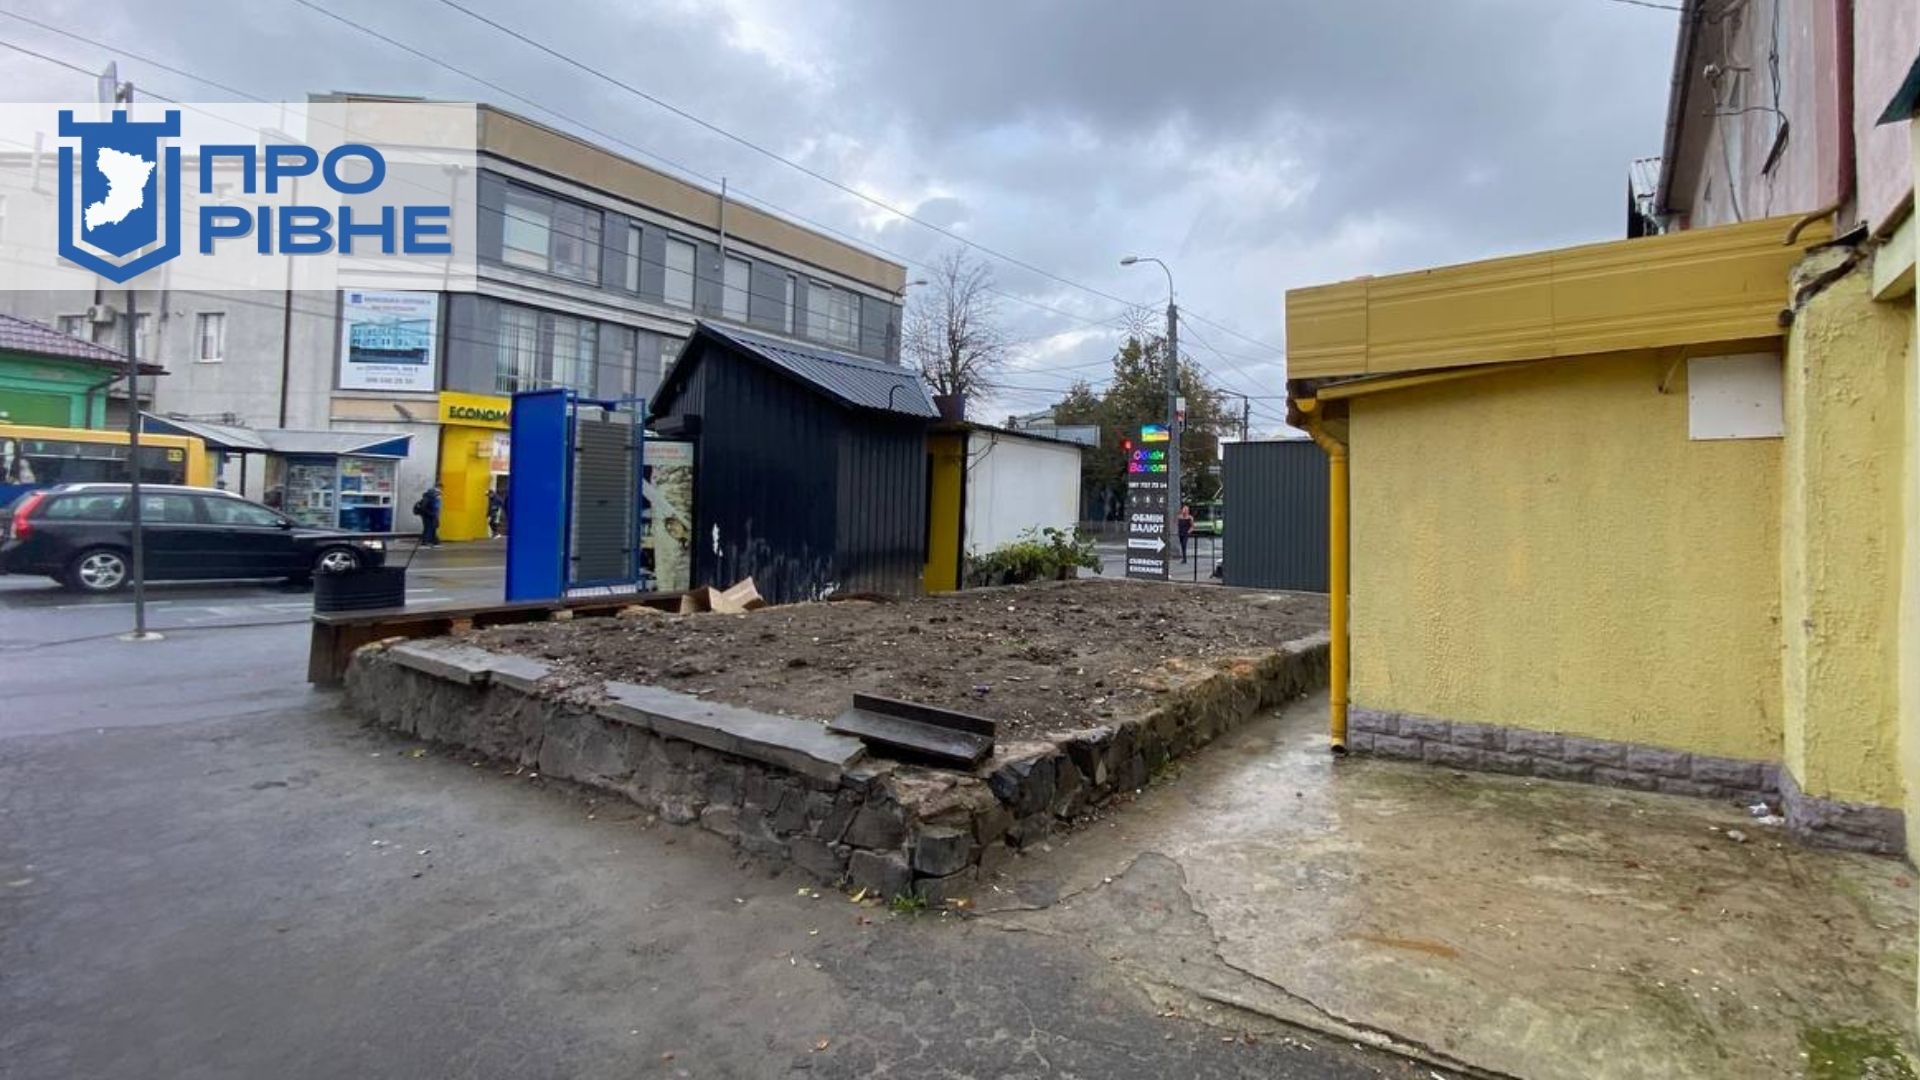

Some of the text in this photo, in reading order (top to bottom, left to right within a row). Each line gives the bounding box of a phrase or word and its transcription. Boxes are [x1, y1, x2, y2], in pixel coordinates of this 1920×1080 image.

[1131, 513, 1164, 523] ОБМІН
[1130, 523, 1164, 533] ВАЛЮТ
[1129, 558, 1164, 566] CURRENCY
[1129, 565, 1164, 575] EXCHANGE
